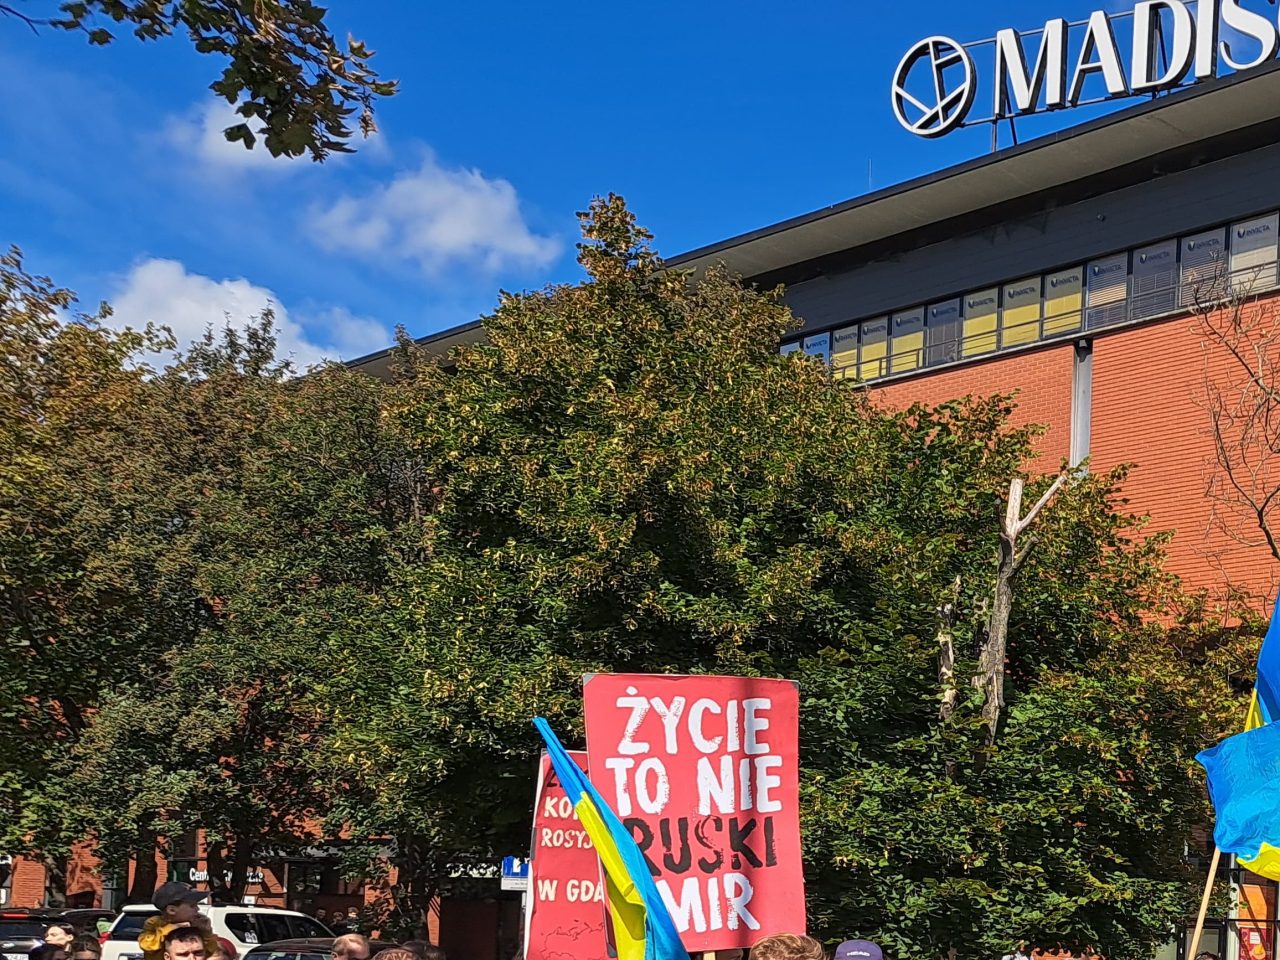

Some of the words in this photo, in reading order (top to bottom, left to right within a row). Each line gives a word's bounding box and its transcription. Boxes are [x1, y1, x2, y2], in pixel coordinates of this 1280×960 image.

[1246, 224, 1271, 237] INVICTA
[616, 686, 772, 755] ŻYCIE
[605, 756, 670, 817] TO
[696, 754, 782, 816] NIE
[541, 828, 595, 849] ROSYJ
[537, 879, 558, 902] W
[566, 880, 604, 903] GDA
[655, 872, 761, 933] MIR
